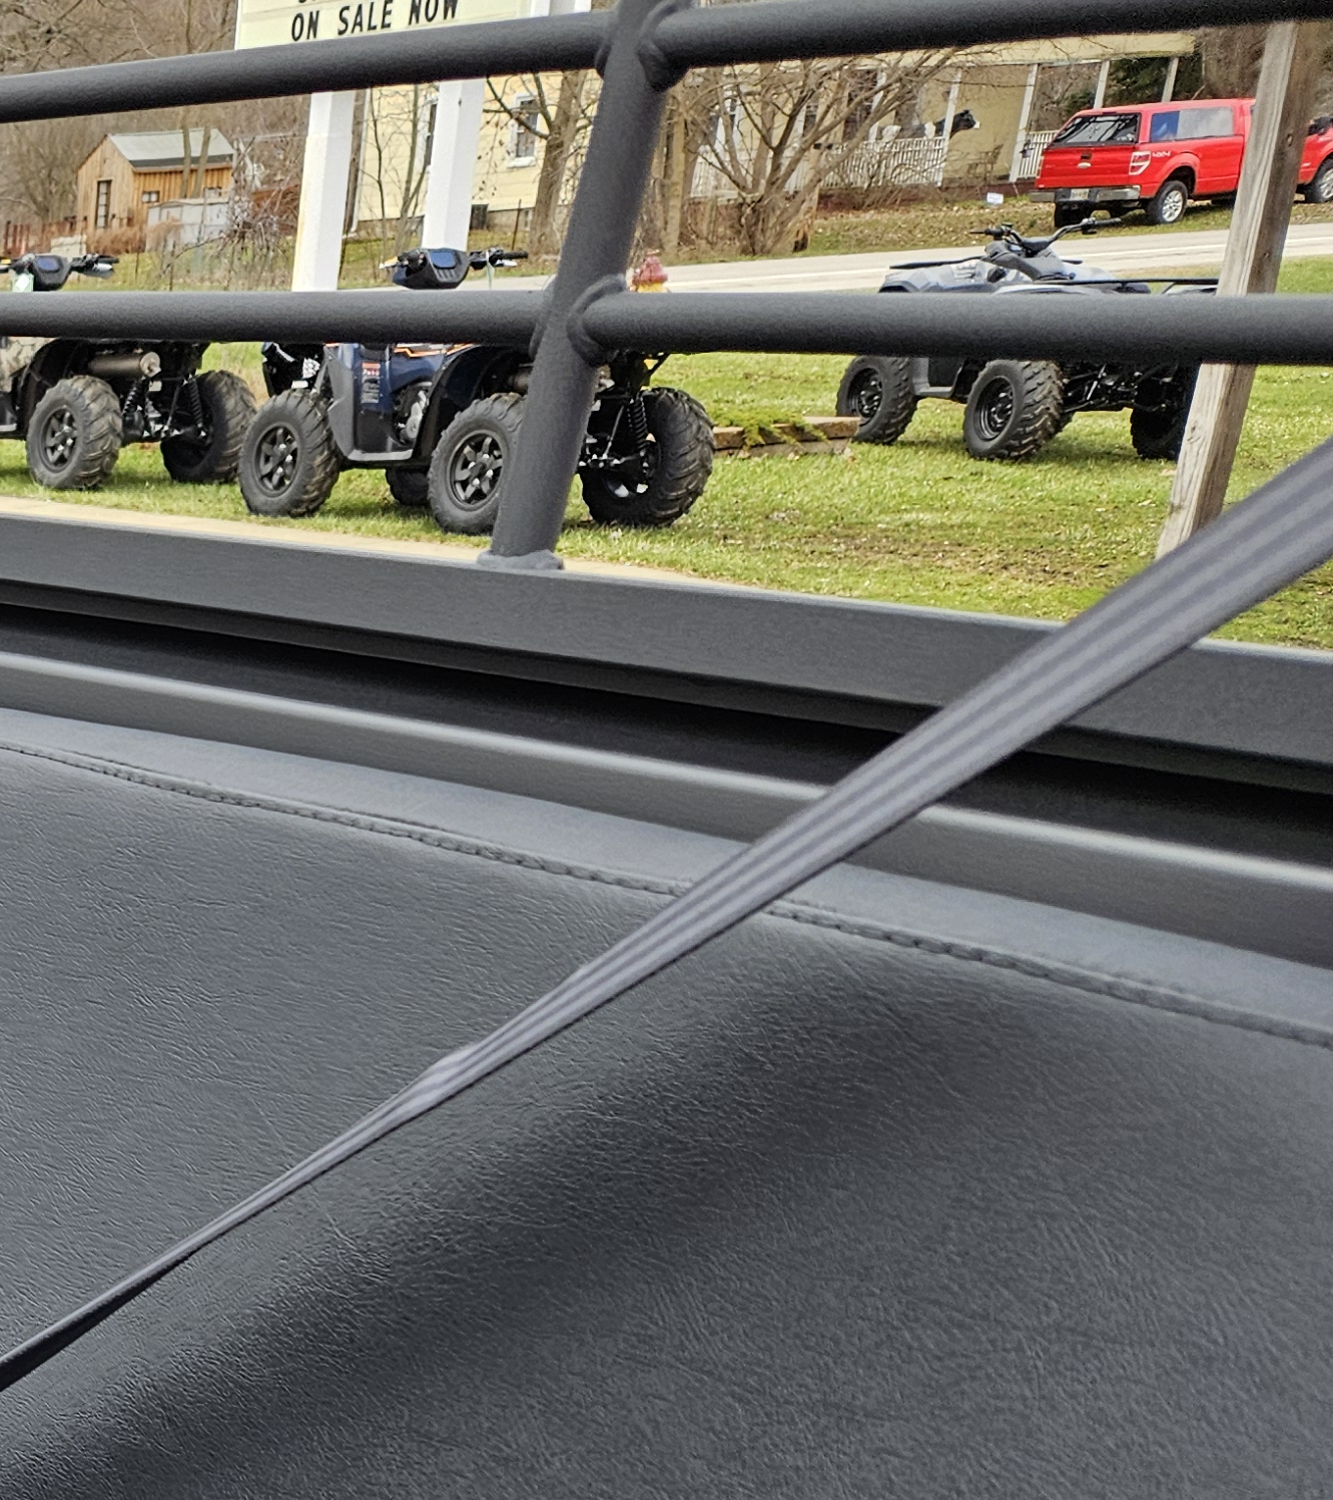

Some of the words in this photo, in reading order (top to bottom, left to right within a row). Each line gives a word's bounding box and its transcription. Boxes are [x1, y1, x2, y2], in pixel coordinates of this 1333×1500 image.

[291, 10, 320, 42] ON
[337, 0, 393, 36] SALE
[408, 0, 459, 26] NOW
